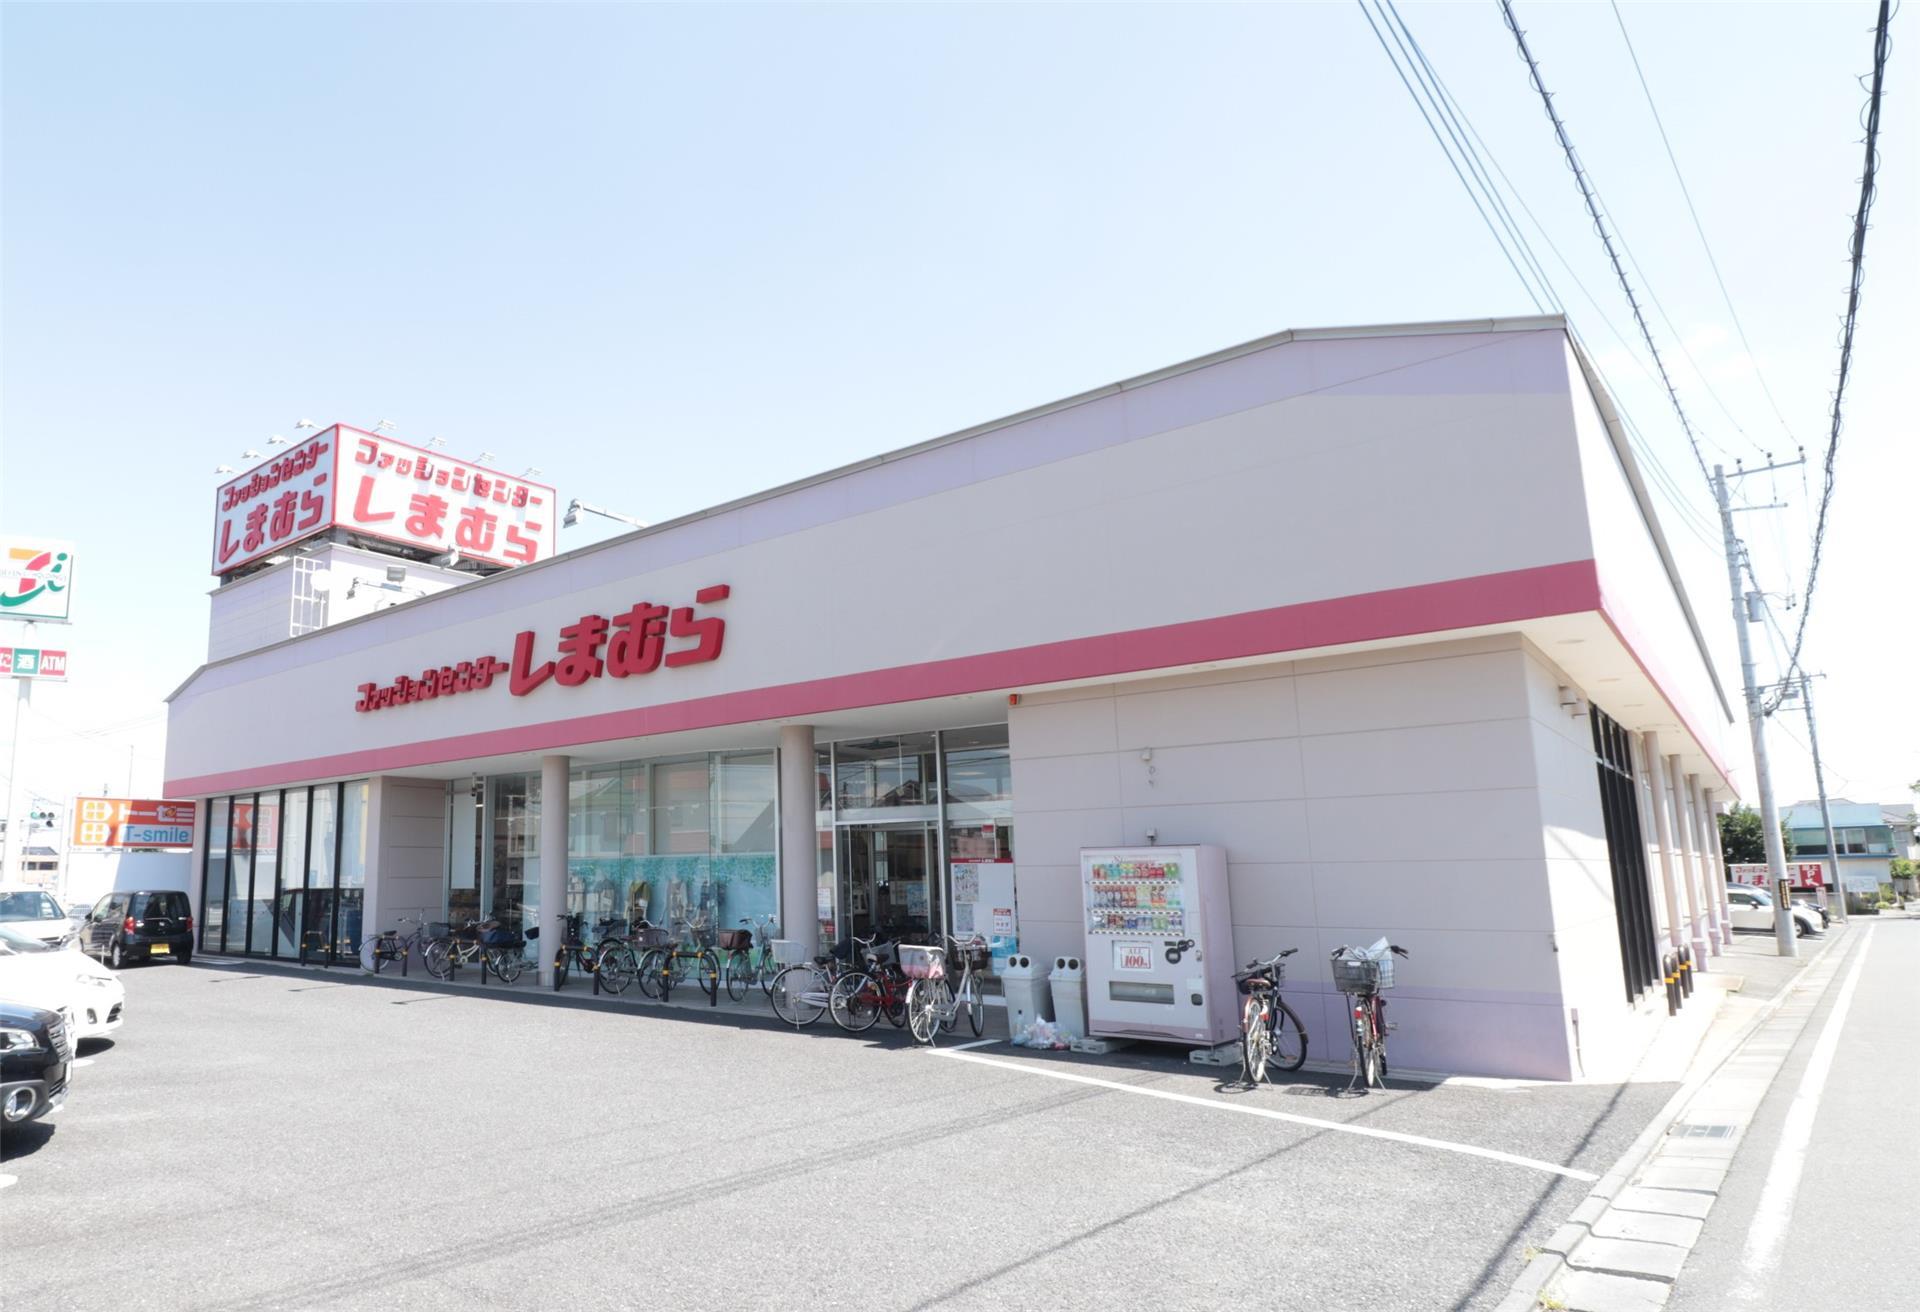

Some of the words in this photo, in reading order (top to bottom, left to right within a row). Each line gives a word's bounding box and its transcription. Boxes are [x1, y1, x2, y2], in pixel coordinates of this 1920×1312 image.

[222, 442, 329, 512] ファッションセンター
[355, 438, 543, 508] ファッションセンター
[219, 473, 327, 564] しまむら
[353, 475, 542, 563] しまむら
[41, 655, 65, 671] ATM
[356, 656, 509, 712] ファッションセンター
[508, 584, 731, 697] しまむら
[126, 825, 189, 842] T-smile
[1807, 870, 1816, 878] P
